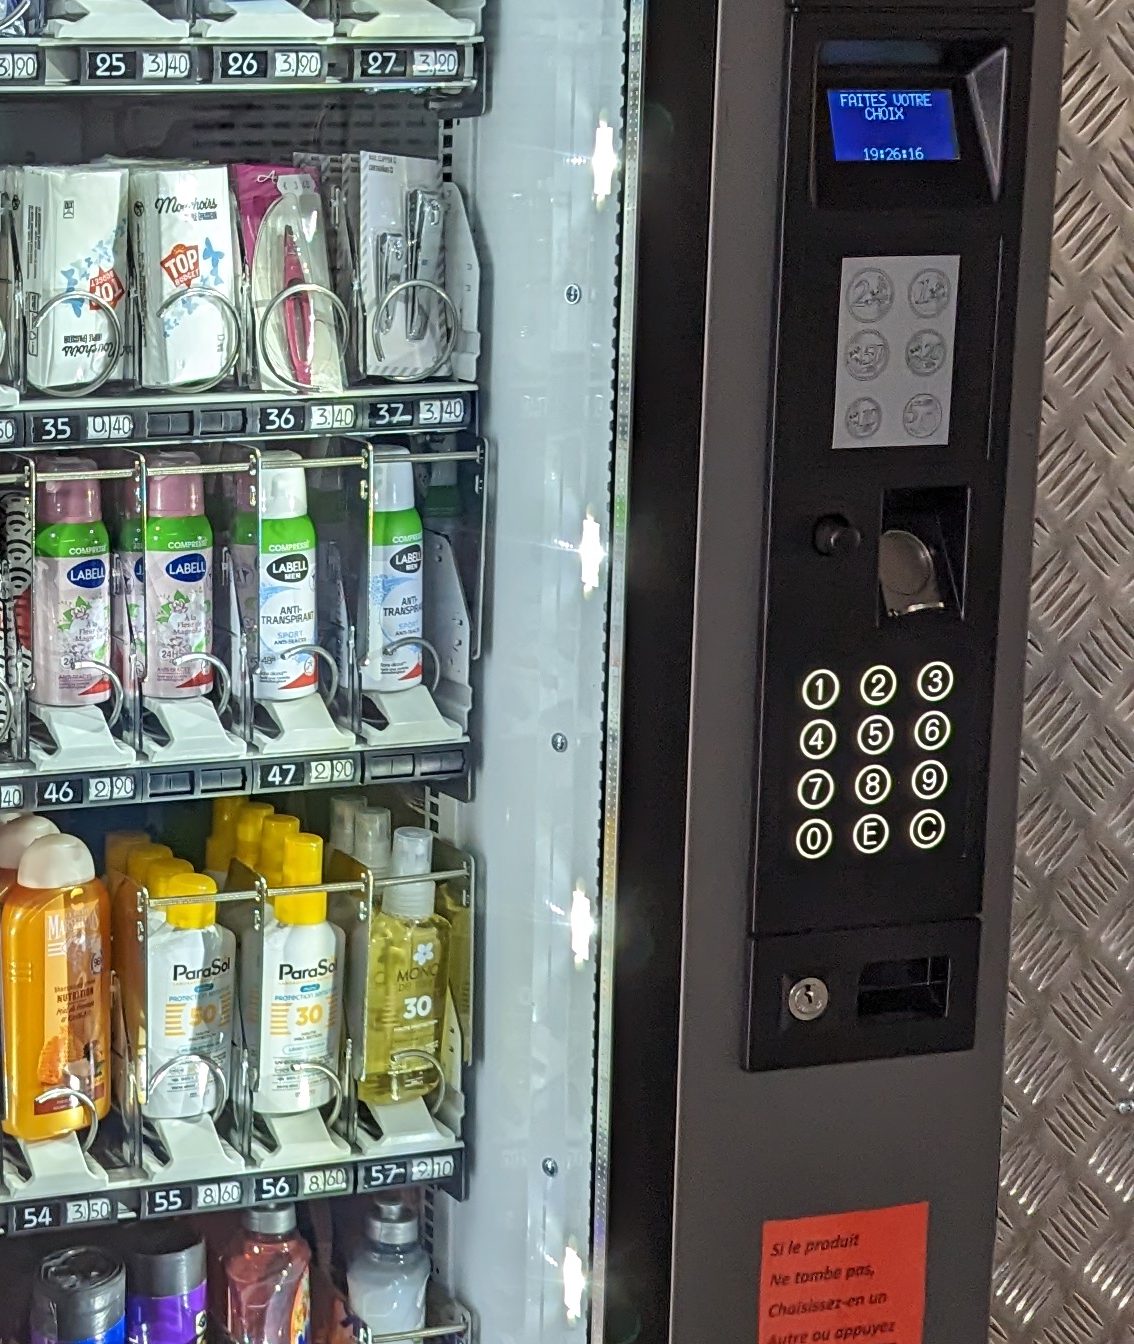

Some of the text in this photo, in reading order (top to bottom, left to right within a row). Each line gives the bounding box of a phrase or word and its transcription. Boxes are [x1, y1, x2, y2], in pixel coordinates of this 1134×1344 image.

[227, 54, 258, 75] 26
[840, 93, 932, 107] FAITES VOTRE
[865, 107, 904, 120] CHOIX
[863, 147, 924, 161] 19:26:16
[165, 246, 198, 273] TOP
[376, 402, 405, 424] 37
[41, 416, 71, 439] 35
[70, 567, 106, 581] LABELL
[169, 561, 206, 575] LABELL
[272, 561, 307, 574] LABELL
[284, 572, 301, 580] MEN
[261, 610, 314, 625] TRANSPIRANT
[815, 669, 942, 699] 1 2 3
[808, 719, 939, 749] 4 5 6
[267, 763, 296, 784] 47
[808, 769, 937, 799] 7 8 9
[806, 818, 936, 849] 0 E C
[173, 957, 230, 981] ParaSol
[278, 958, 338, 981] ParaSol
[189, 1005, 216, 1026] 50
[295, 1004, 323, 1026] 30
[403, 995, 432, 1019] 30
[371, 1164, 397, 1184] 57
[154, 1190, 182, 1211] 55
[770, 1233, 860, 1256] Si le produit
[770, 1272, 789, 1286] Ne
[795, 1266, 841, 1284] tombe
[768, 1292, 887, 1318] Choisissez-en un
[812, 1329, 830, 1341] ou
[835, 1320, 896, 1341] appuyez
